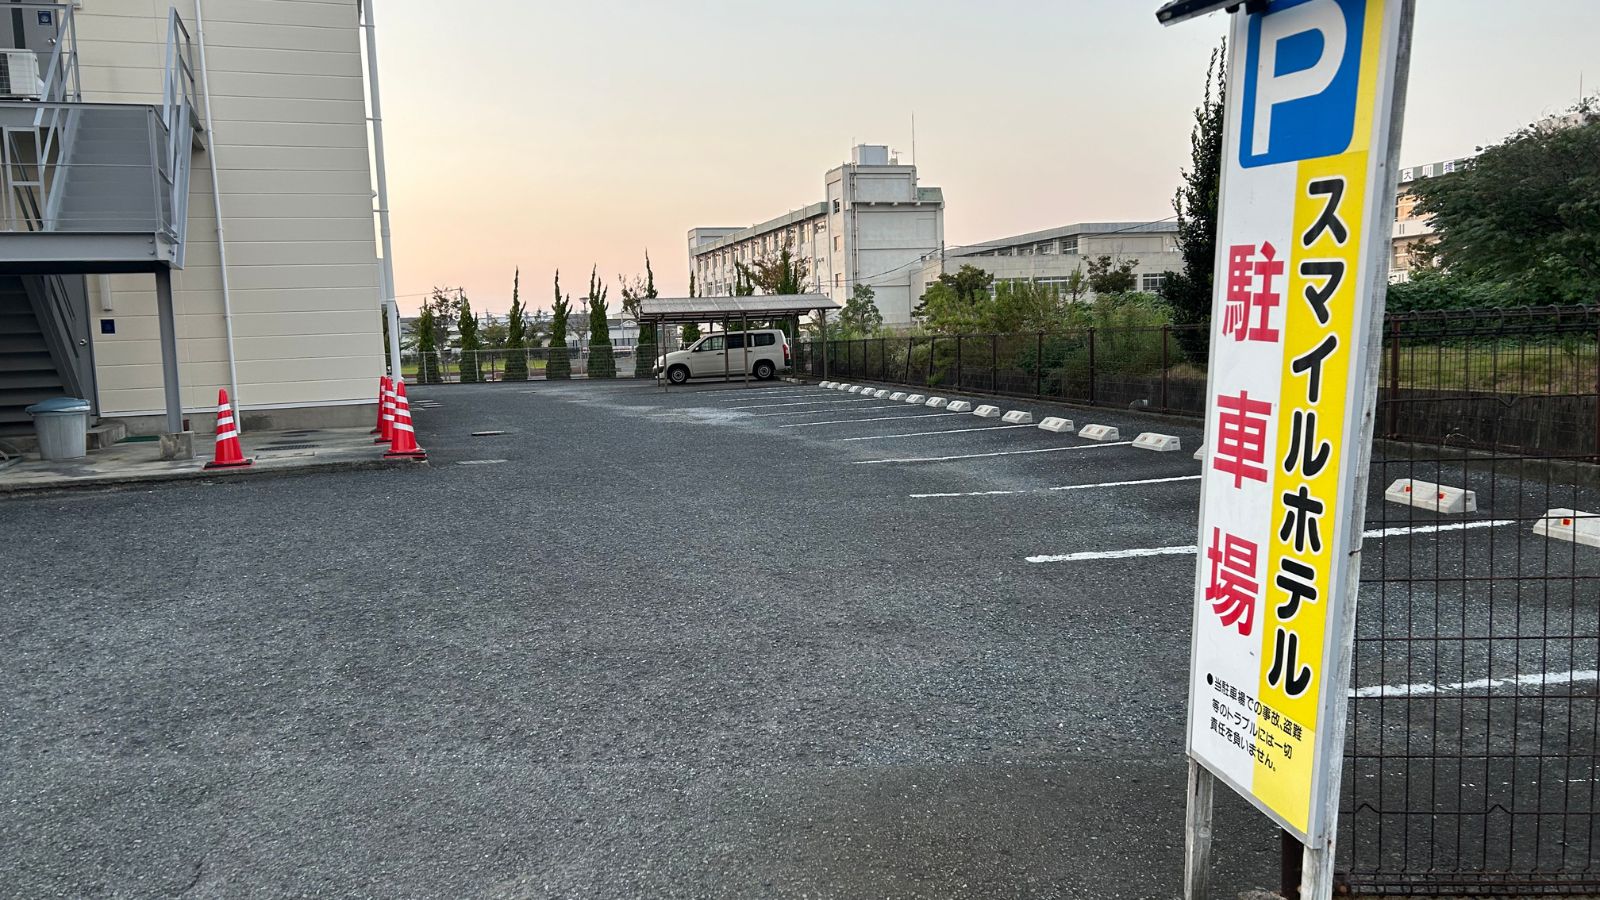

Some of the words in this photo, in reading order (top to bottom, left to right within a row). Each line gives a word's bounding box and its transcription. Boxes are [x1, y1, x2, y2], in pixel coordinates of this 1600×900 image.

[1251, 0, 1347, 157] P
[1205, 240, 1285, 637] 駐車場
[1268, 178, 1348, 697] スマイルホテル
[1209, 716, 1277, 772] 責任を負いません。
